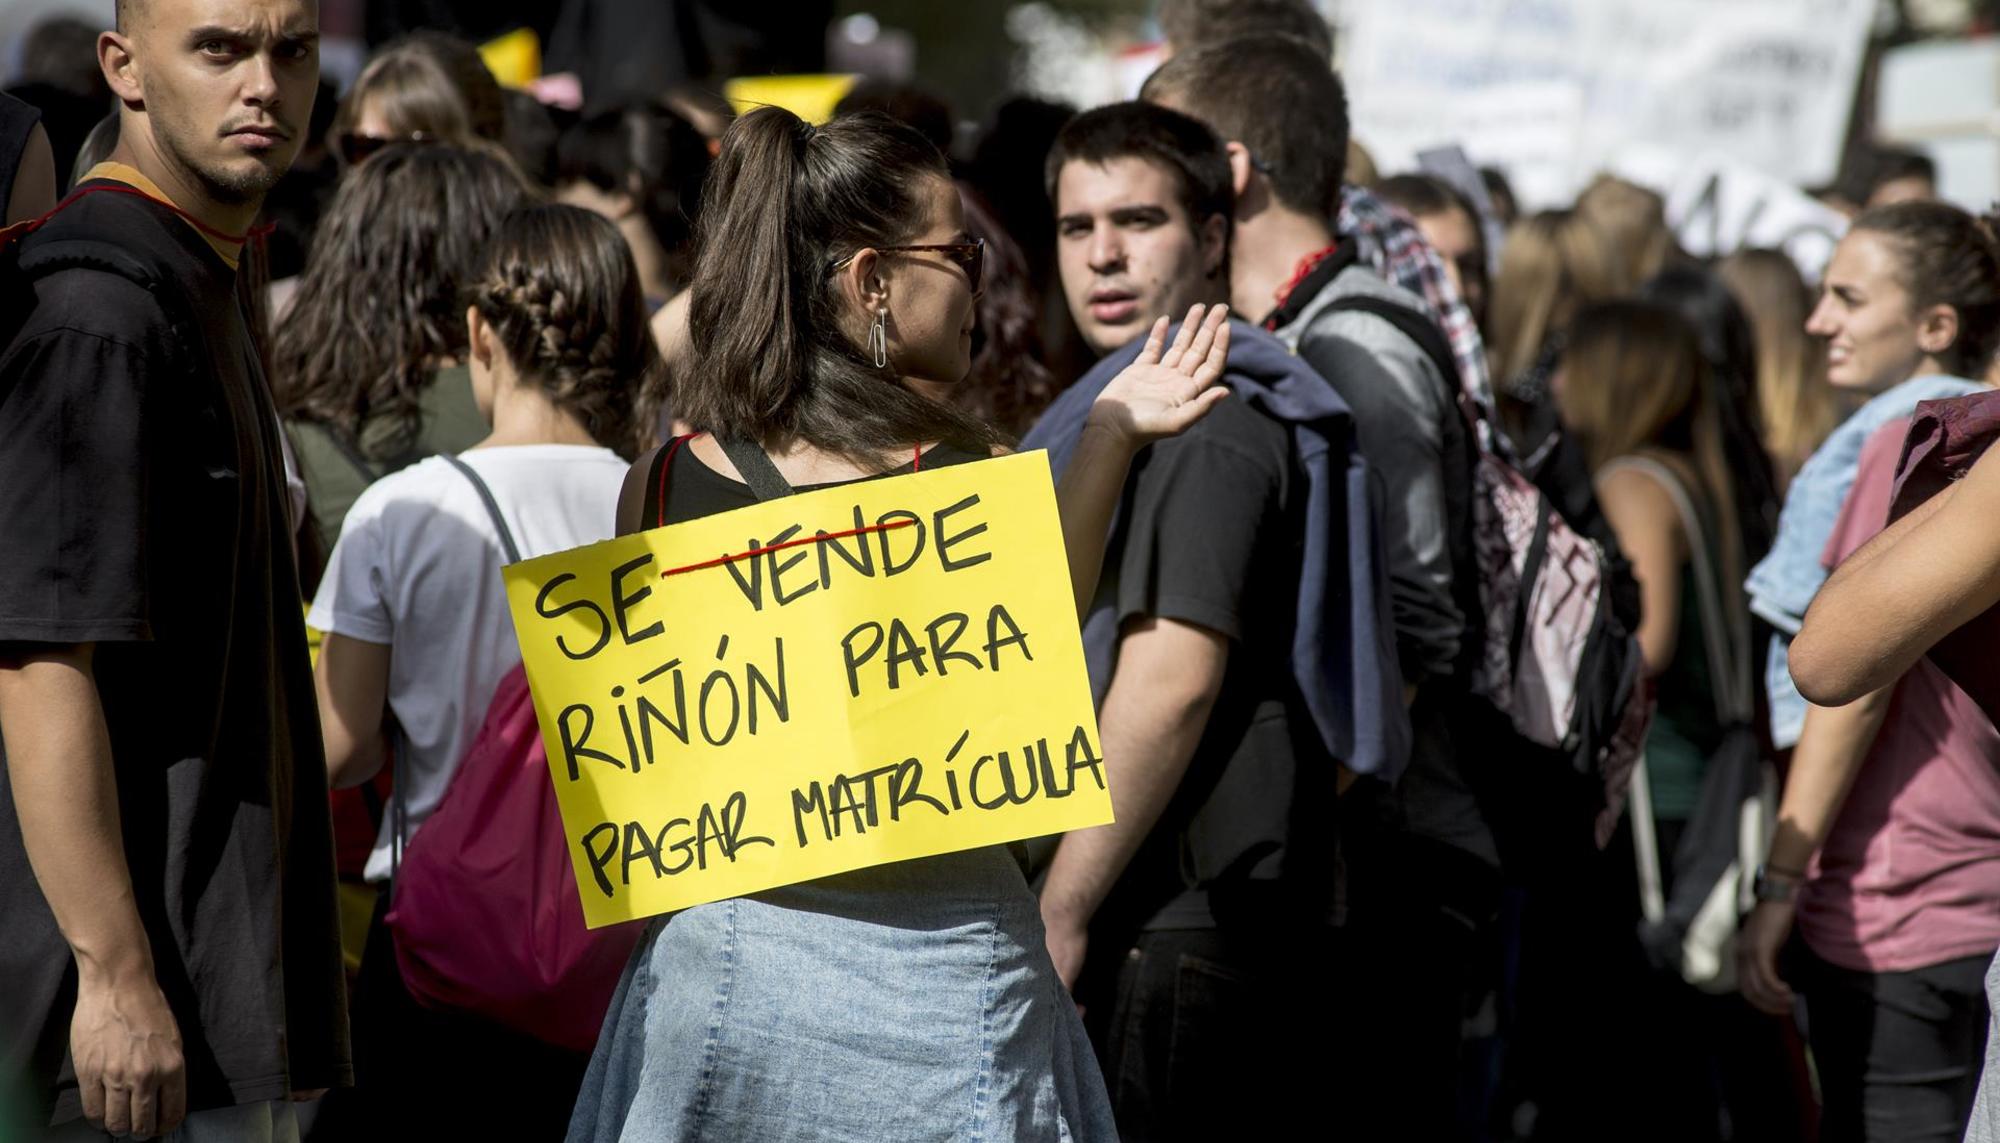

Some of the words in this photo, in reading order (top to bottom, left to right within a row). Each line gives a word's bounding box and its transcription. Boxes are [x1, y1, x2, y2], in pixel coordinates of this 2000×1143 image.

[534, 553, 664, 660] SE
[722, 494, 991, 611] VENDE
[841, 605, 1032, 697] PARA
[581, 792, 774, 898] PAGAR
[792, 726, 1105, 847] MATRÍCULA
